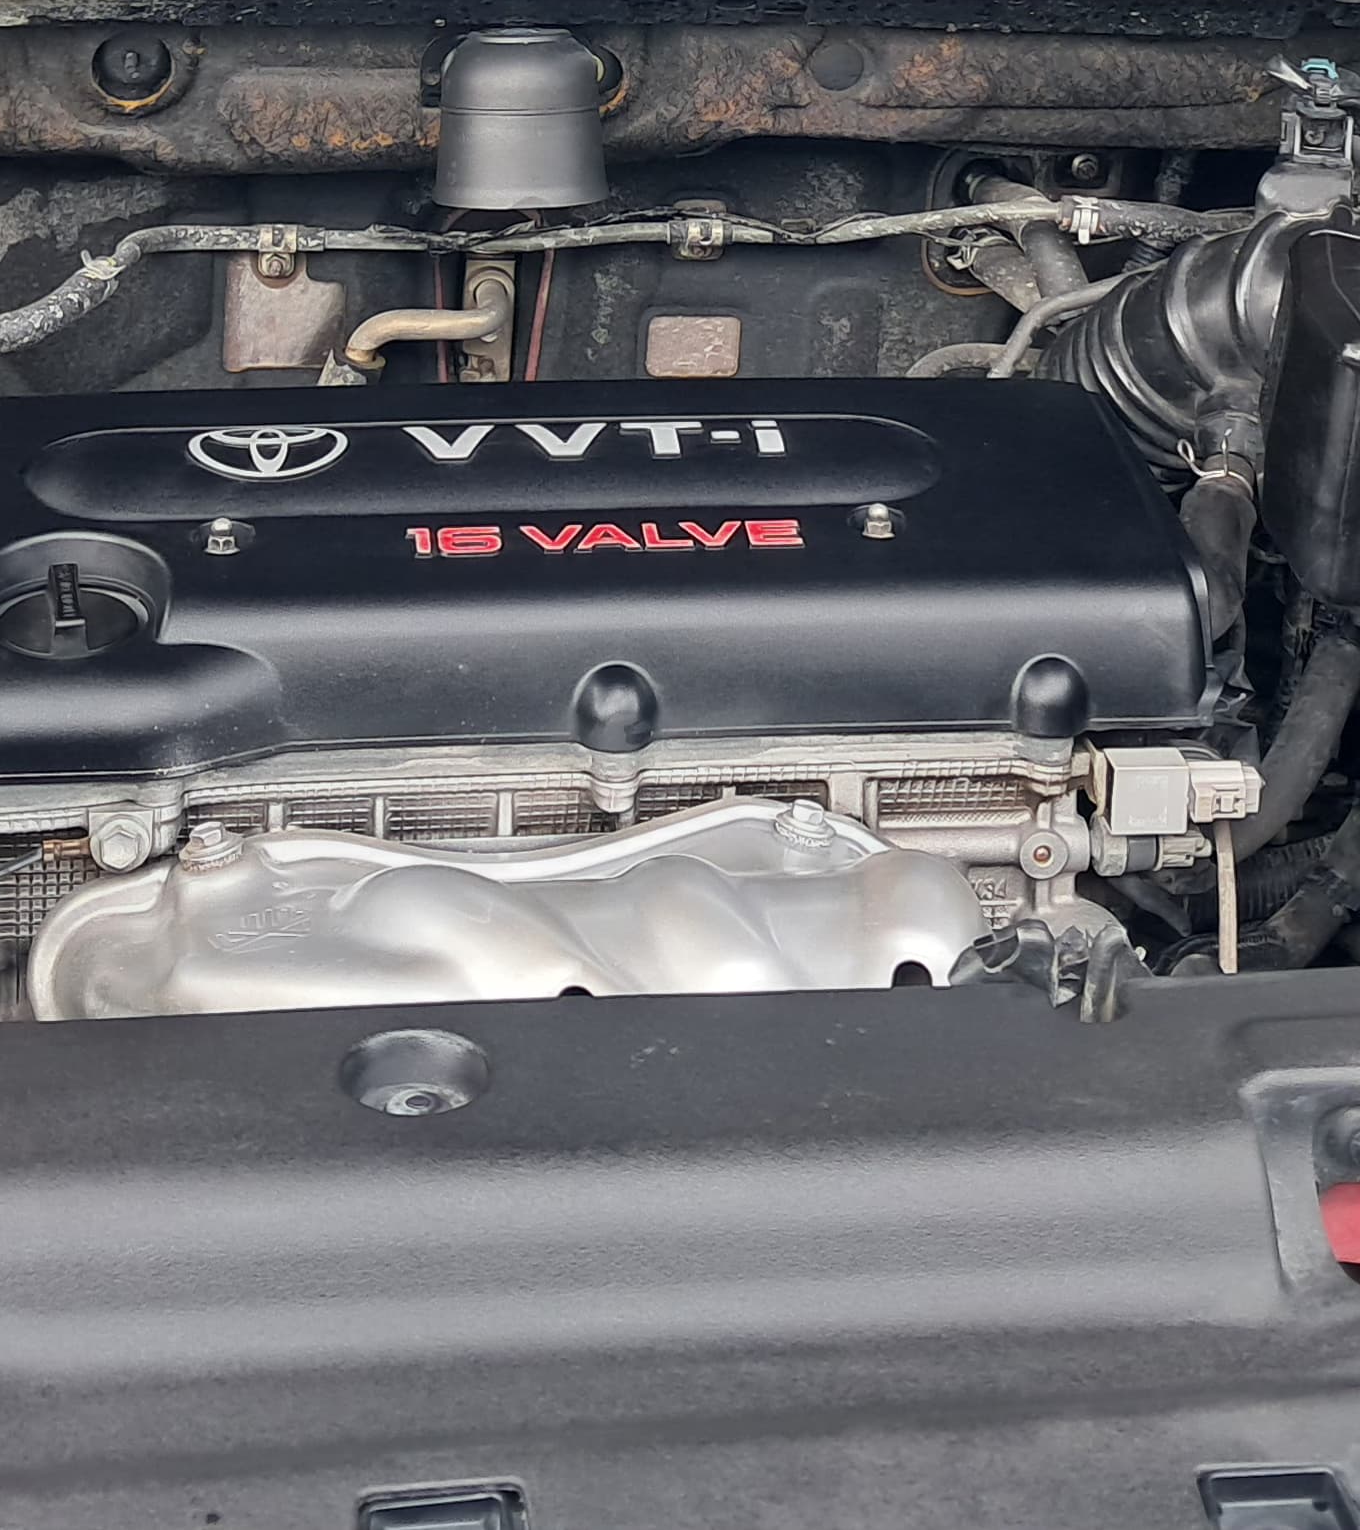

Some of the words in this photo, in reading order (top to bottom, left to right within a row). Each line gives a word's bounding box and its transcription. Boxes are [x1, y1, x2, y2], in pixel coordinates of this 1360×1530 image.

[402, 420, 787, 460] VVT-i
[406, 525, 502, 557] 16
[519, 519, 805, 553] VALVE
